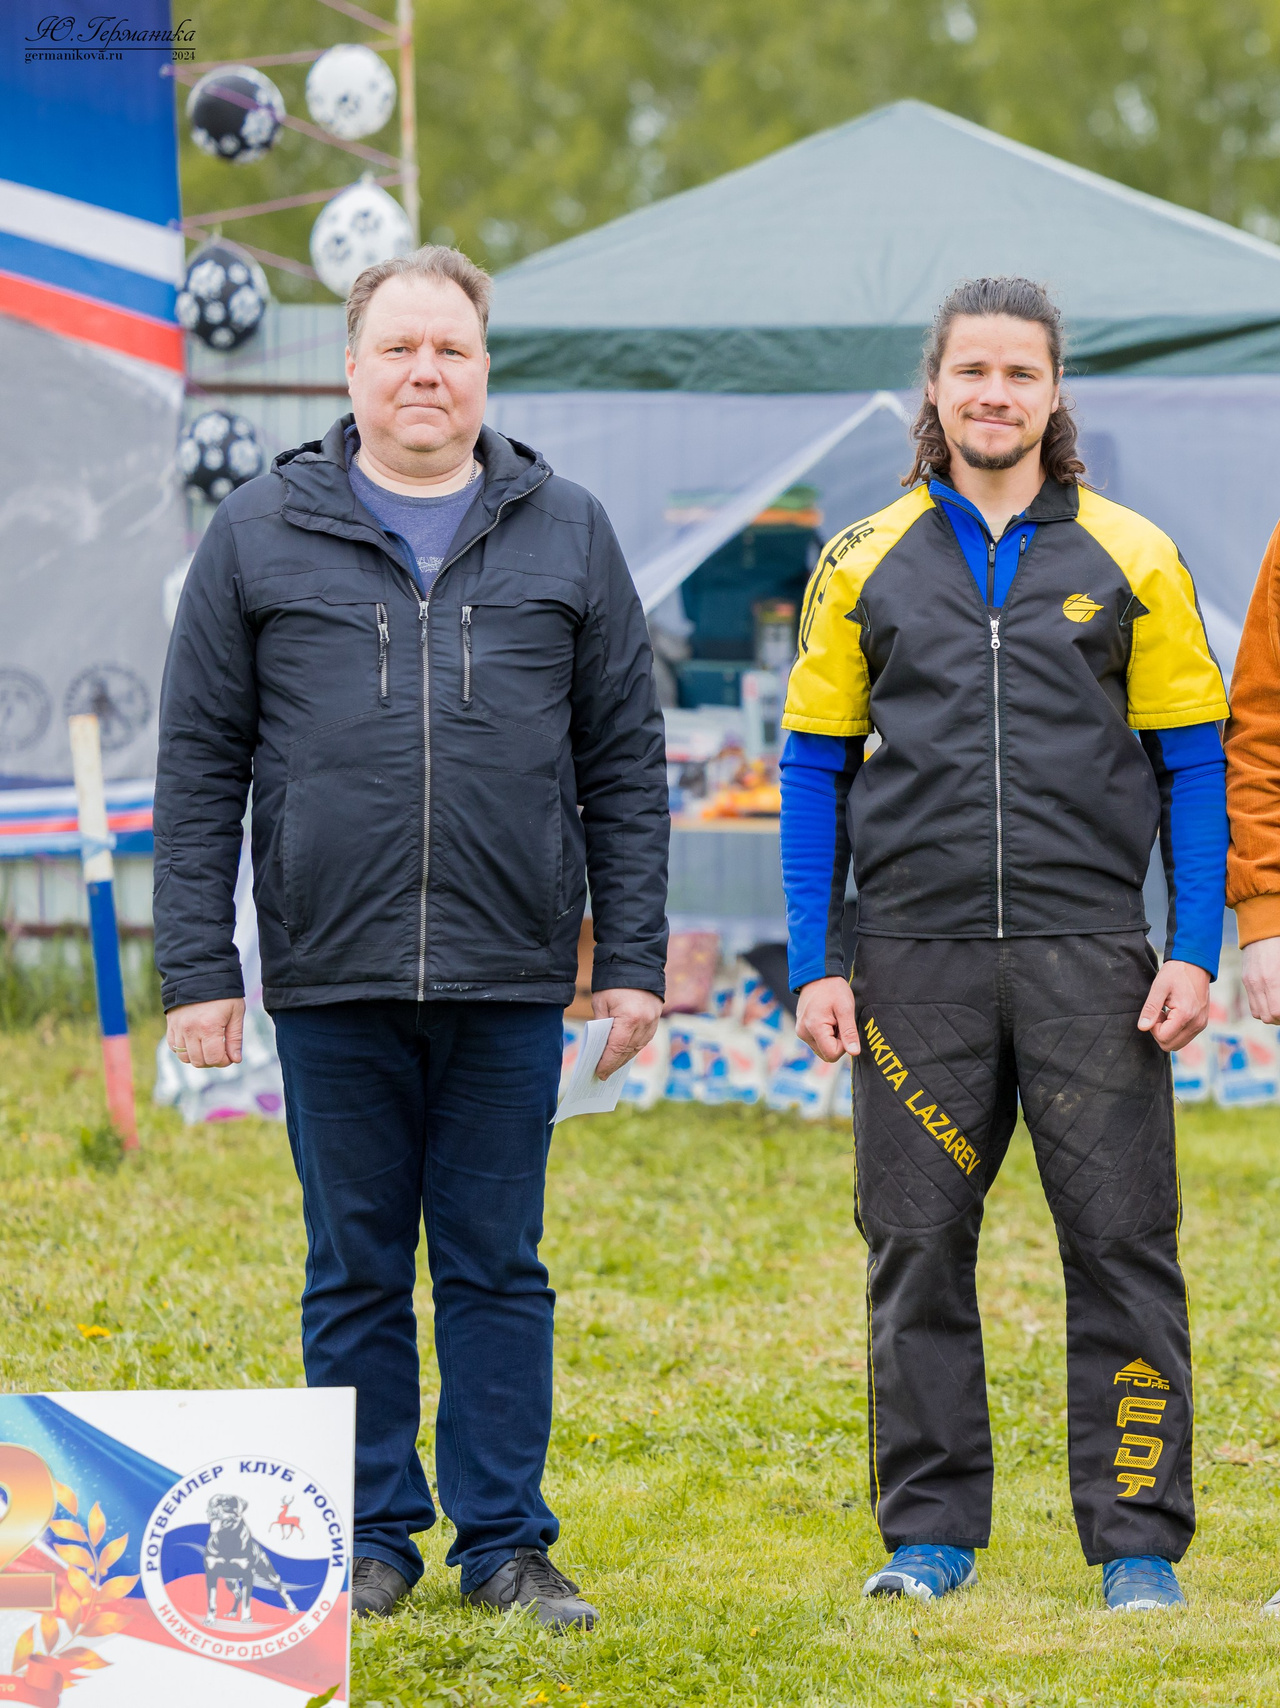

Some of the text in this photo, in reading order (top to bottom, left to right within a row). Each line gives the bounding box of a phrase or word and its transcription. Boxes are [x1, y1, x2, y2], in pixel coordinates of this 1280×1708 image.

[864, 1017, 981, 1176] NIKITA LAZAREV
[146, 1461, 344, 1572] РОТВЕЙЛЕР КЛУБ РОССИИ
[158, 1600, 331, 1659] НИЖЕГОРОДСКОЕ РО
